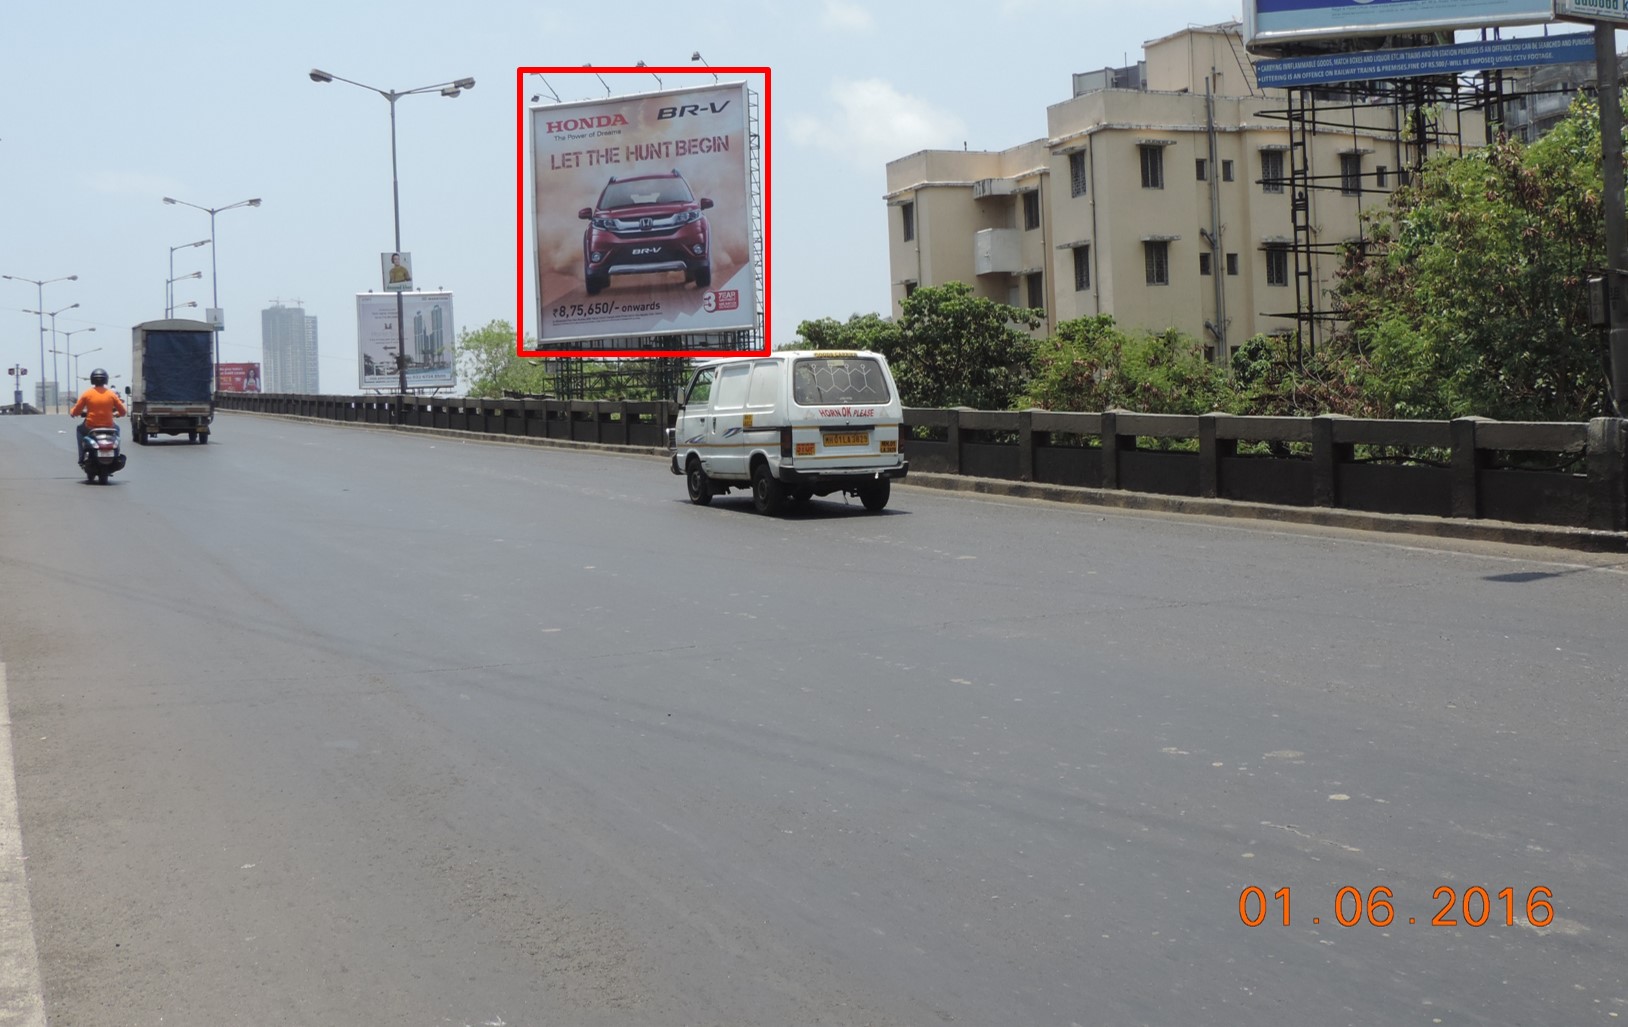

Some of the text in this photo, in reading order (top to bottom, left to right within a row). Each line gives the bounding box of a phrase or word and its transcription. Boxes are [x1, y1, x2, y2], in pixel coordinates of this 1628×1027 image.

[1260, 63, 1282, 72] CARRYING
[1334, 57, 1349, 67] MATCH
[1350, 56, 1363, 65] BOXES
[1364, 55, 1374, 63] AND
[1374, 53, 1390, 62] LIQUOR
[1405, 51, 1420, 60] TRAINS
[1421, 50, 1431, 58] AND
[1432, 49, 1439, 57] ON
[1440, 48, 1457, 57] STATION
[1457, 46, 1479, 55] PREMISES
[1485, 45, 1491, 53] AN
[1538, 40, 1561, 49] SEARCHED
[1561, 39, 1571, 47] AND
[1572, 38, 1595, 46] PUNISHED
[1261, 73, 1287, 83] LITTERING
[1302, 70, 1324, 79] OFFENCE
[1334, 66, 1356, 76] RAILWAY
[1357, 65, 1375, 74] TRAINS
[1420, 61, 1427, 69] OF
[1495, 55, 1512, 63] USING
[1513, 53, 1526, 61] CCTV
[657, 100, 731, 120] BR-V
[546, 113, 629, 134] HONDA
[567, 133, 587, 141] Power
[597, 129, 622, 138] Dreams
[551, 135, 730, 170] LET THE HUNT BEGIN
[632, 246, 662, 255] BR-V
[621, 301, 661, 313] onwards
[703, 288, 717, 314] 3
[819, 407, 875, 417] HORN OK PLEASE
